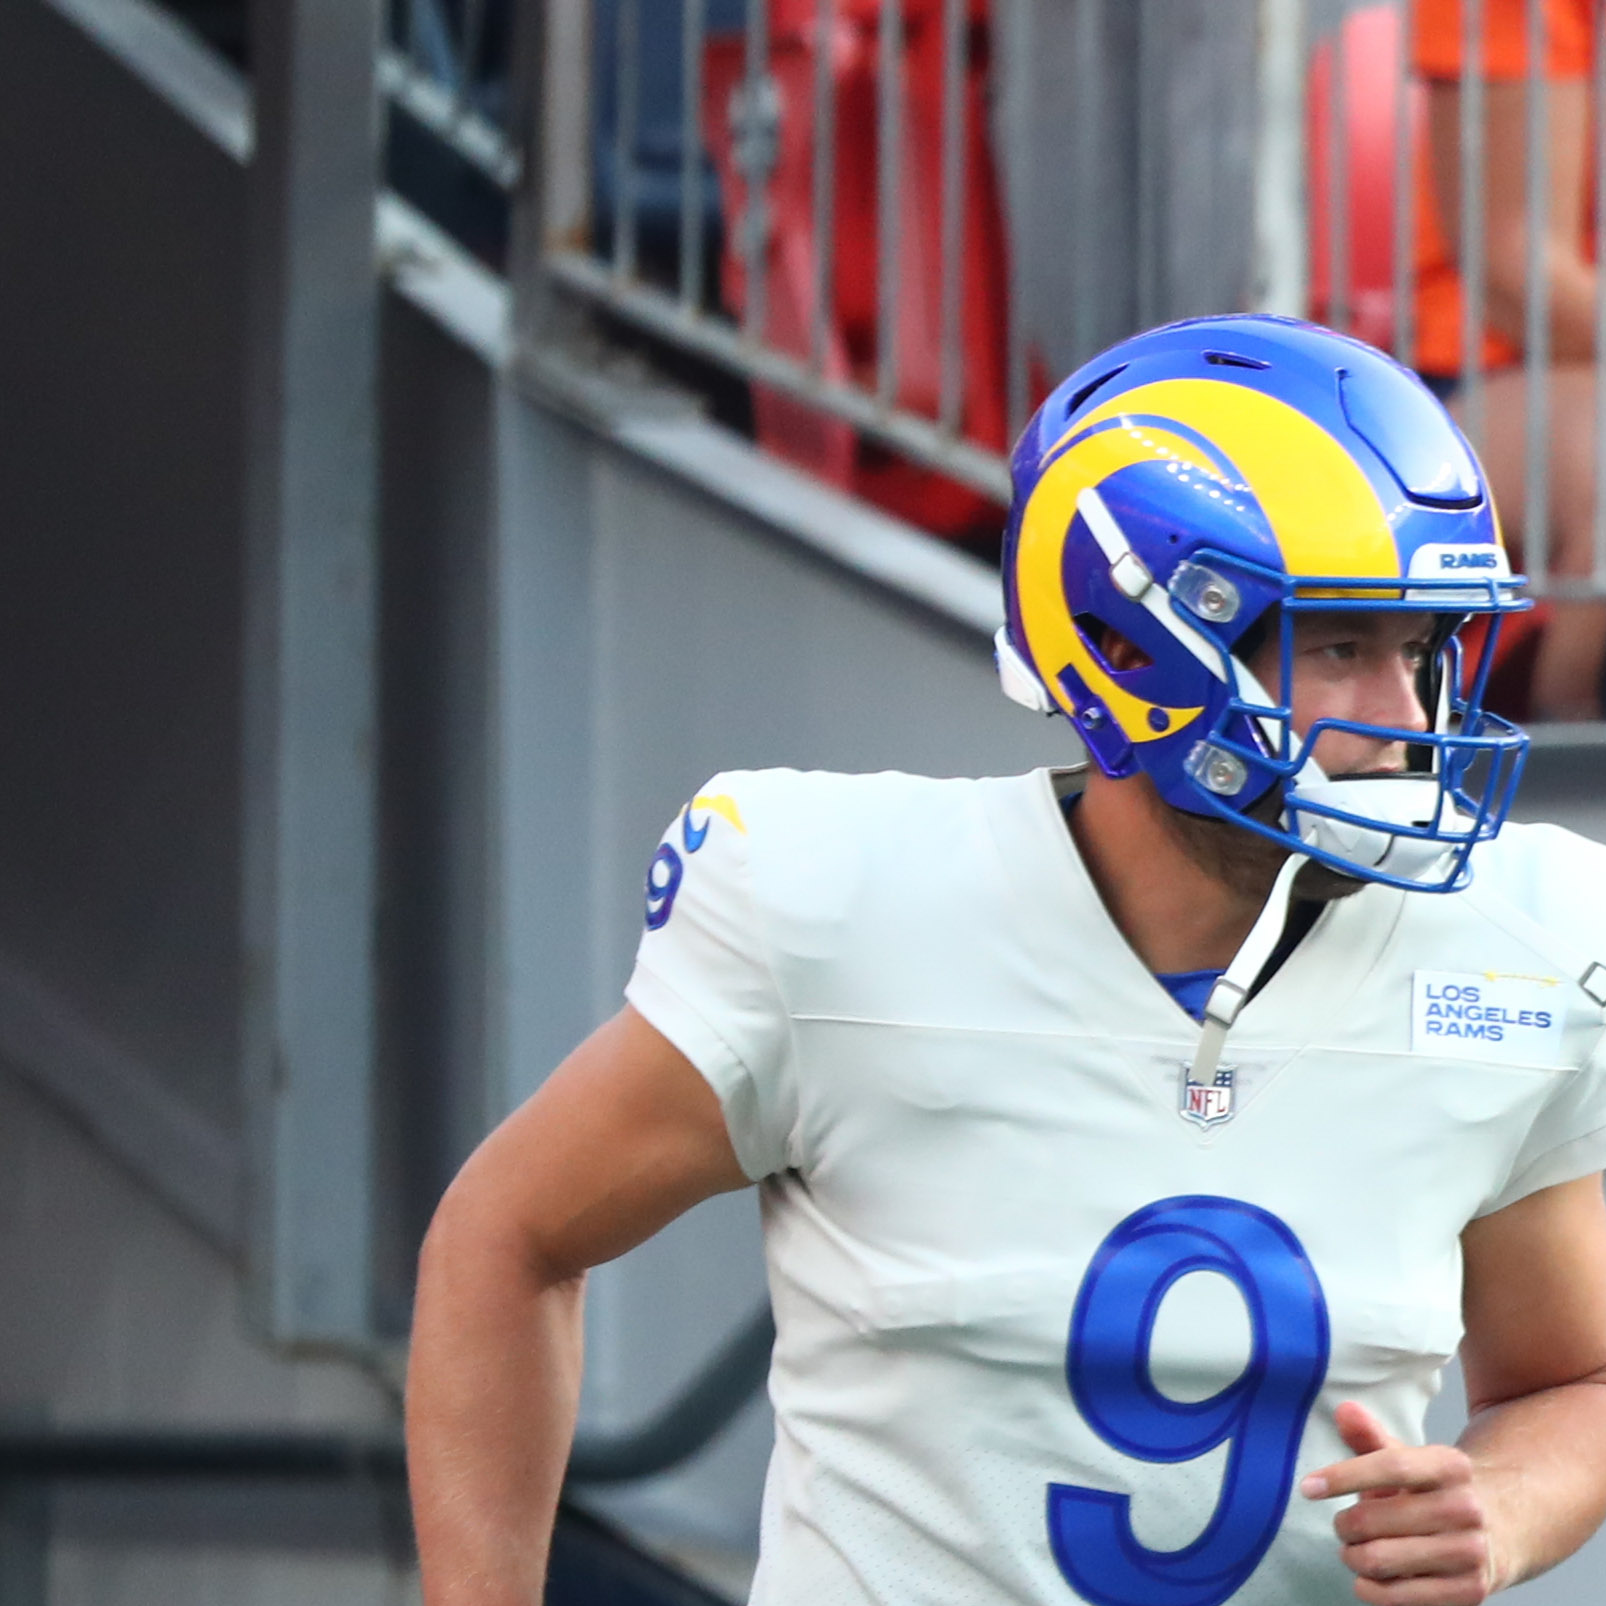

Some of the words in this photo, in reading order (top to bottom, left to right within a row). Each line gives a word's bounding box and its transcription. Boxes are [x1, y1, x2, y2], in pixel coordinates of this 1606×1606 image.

[1439, 552, 1498, 569] RAMS
[645, 842, 684, 932] 9
[1425, 983, 1481, 1003] LOS
[1424, 1002, 1553, 1030] ANGELES
[1425, 1019, 1505, 1043] RAMS
[1188, 1088, 1227, 1117] NFL
